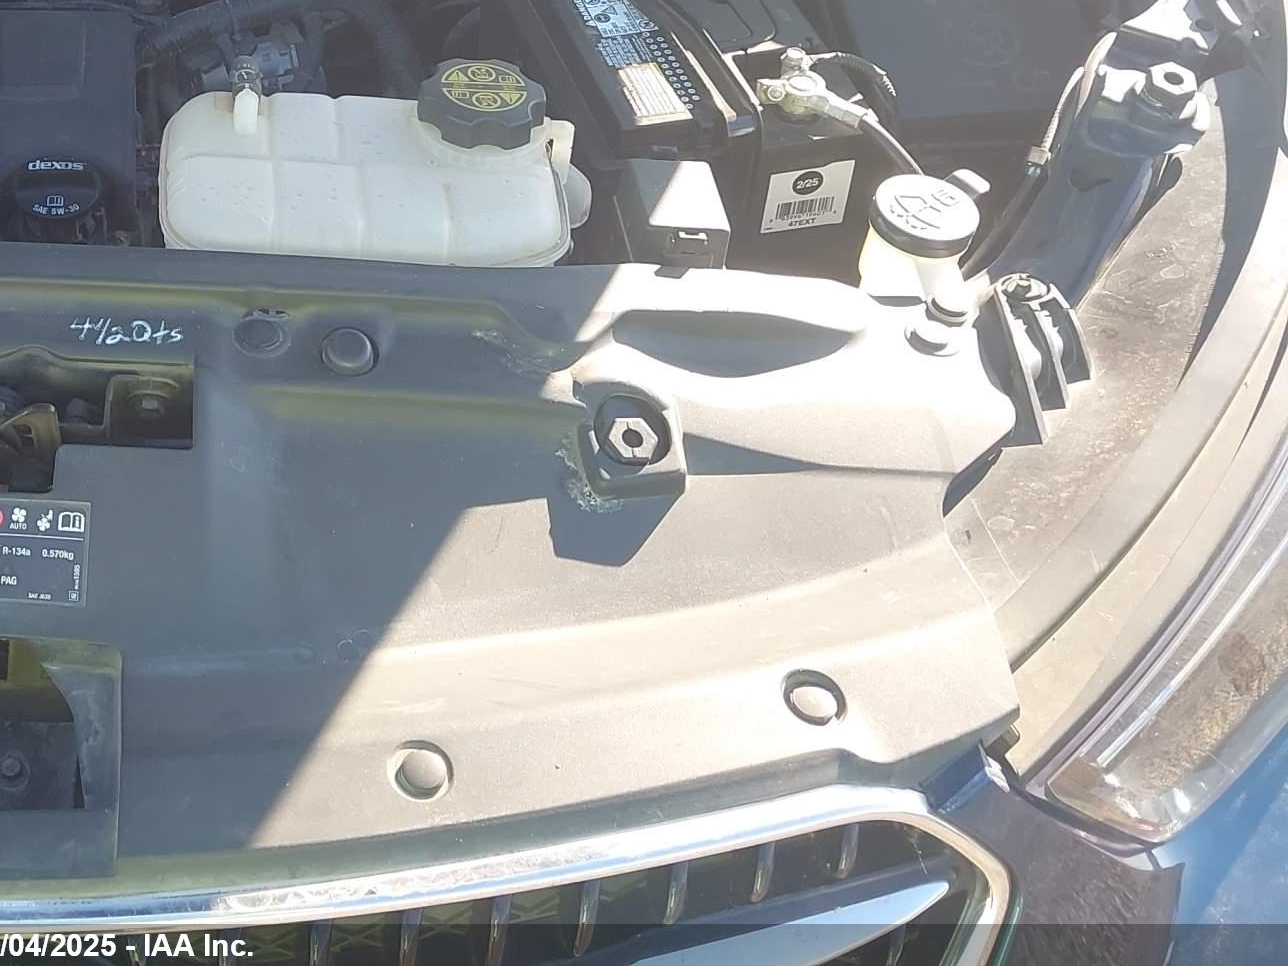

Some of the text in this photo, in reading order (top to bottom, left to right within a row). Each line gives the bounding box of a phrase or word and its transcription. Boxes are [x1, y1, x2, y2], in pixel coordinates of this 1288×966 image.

[27, 159, 85, 171] dexos
[796, 177, 820, 190] 2/25
[32, 203, 80, 215] SAE 5W-30
[9, 522, 28, 531] AUTO
[2, 546, 75, 561] R-134a 0.570kg
[0, 575, 18, 586] PAG
